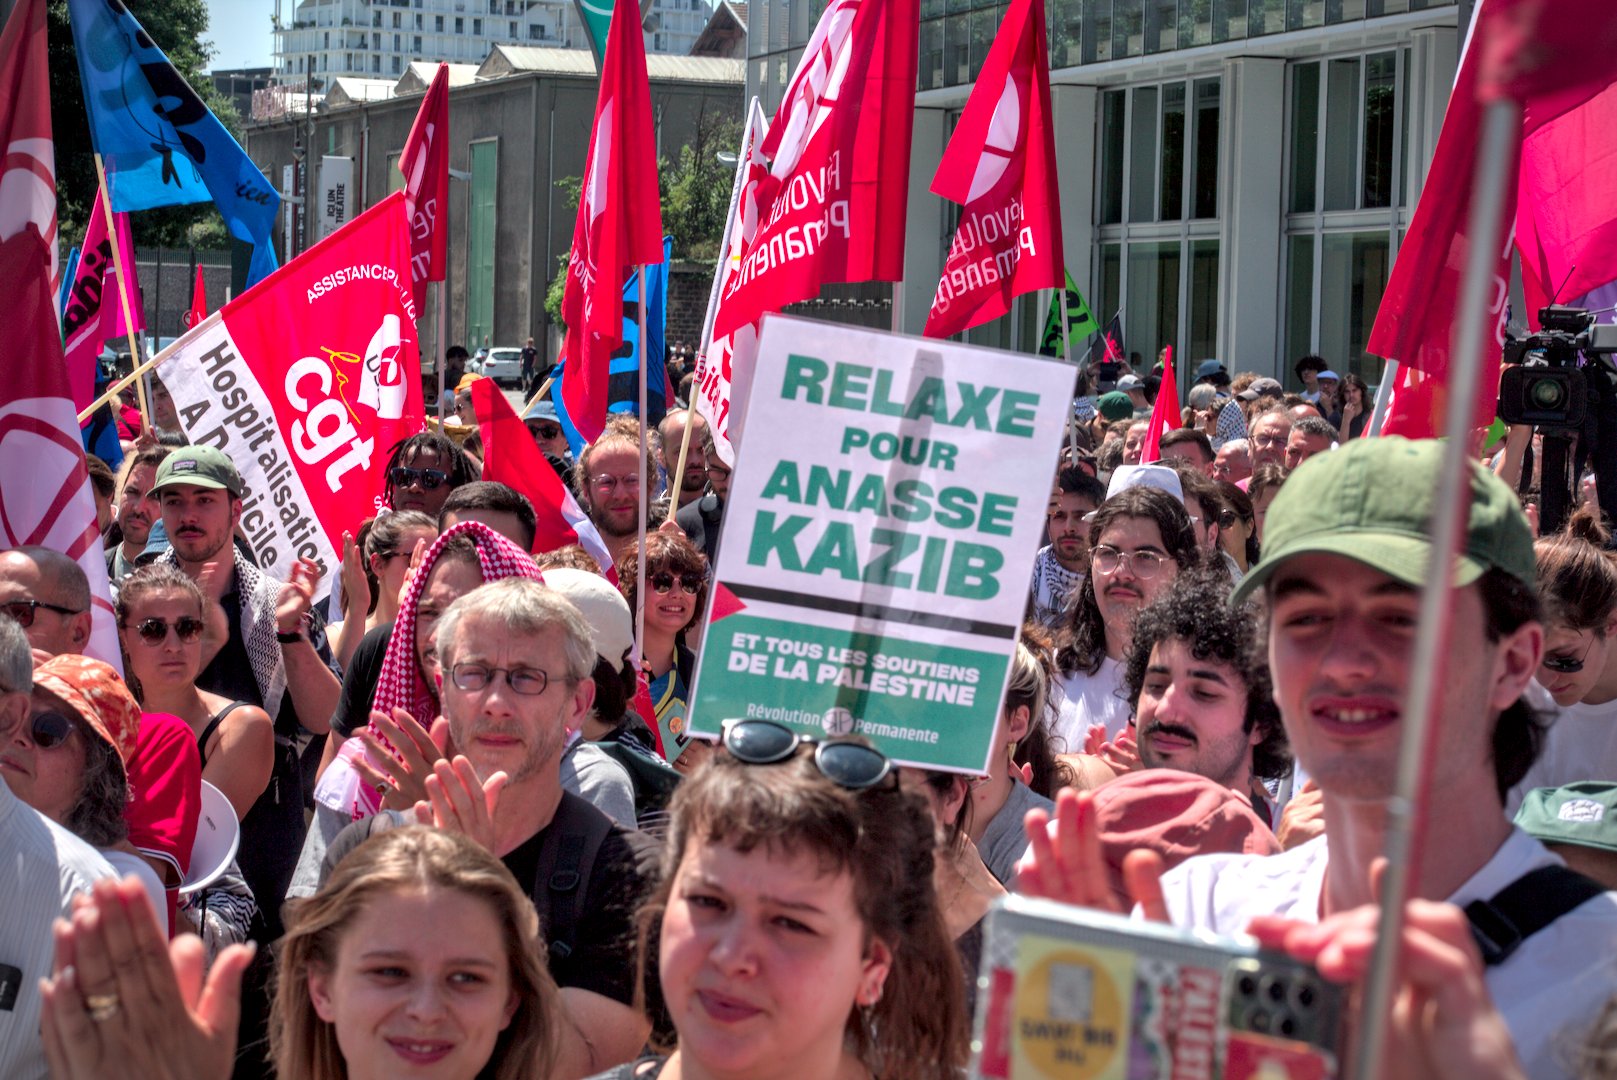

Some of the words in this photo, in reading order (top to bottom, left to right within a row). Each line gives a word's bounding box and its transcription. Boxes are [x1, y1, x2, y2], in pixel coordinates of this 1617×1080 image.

[179, 399, 211, 431] A
[780, 353, 1041, 438] RELAXE
[284, 356, 375, 494] cgt
[840, 426, 959, 471] POUR
[760, 459, 1019, 537] ANASSE
[746, 509, 1005, 601] KAZIB
[727, 650, 769, 676] DE
[773, 658, 810, 682] LA
[816, 663, 976, 707] PALESTINE
[731, 632, 761, 650] ET
[765, 636, 823, 660] TOUS
[827, 646, 868, 666] LES
[872, 653, 980, 684] SOUTIENS
[746, 702, 820, 727] Révolution
[854, 718, 940, 745] Permanente
